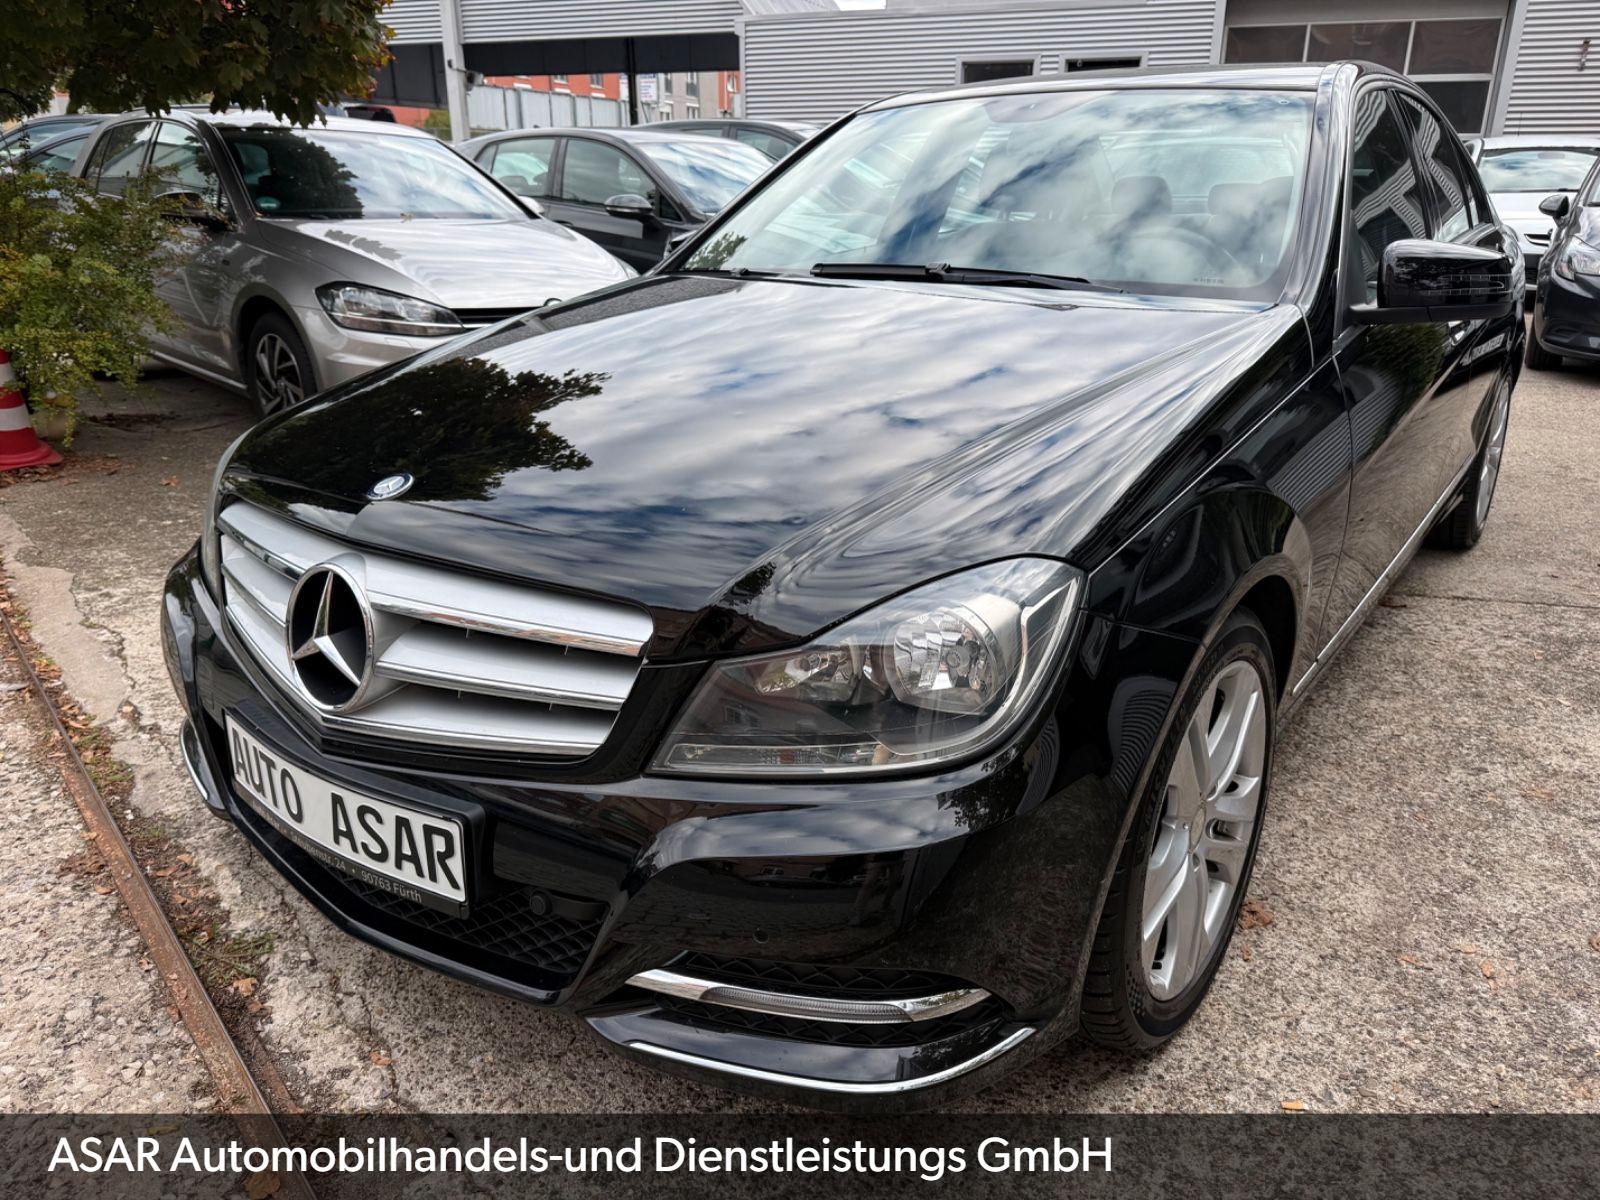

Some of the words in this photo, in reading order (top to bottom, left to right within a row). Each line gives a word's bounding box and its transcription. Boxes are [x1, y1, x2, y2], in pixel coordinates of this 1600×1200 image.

[232, 727, 304, 824] AUTO
[331, 792, 460, 890] ASAR
[361, 869, 392, 891] 90763
[393, 882, 422, 903] Fürth
